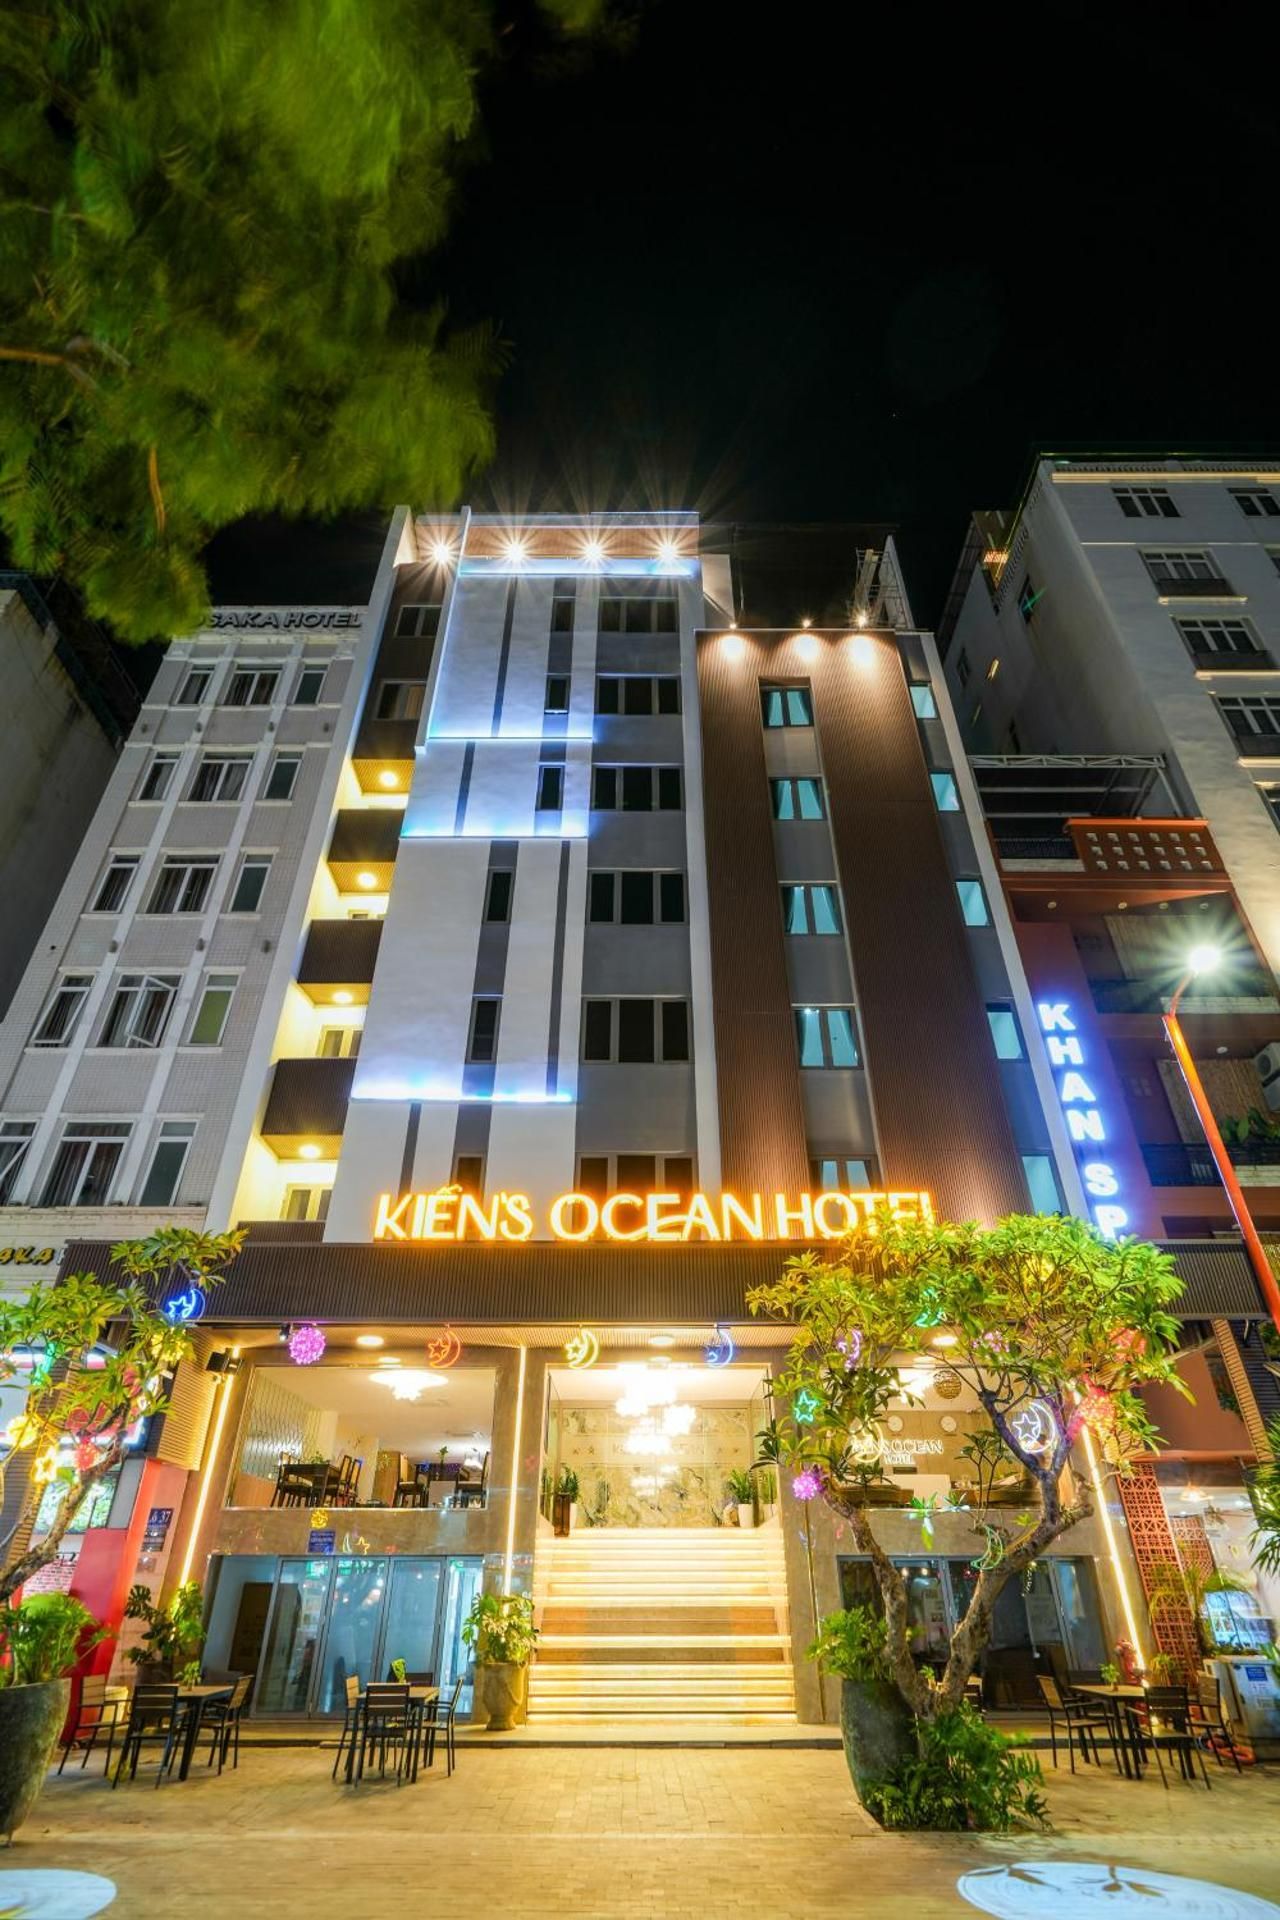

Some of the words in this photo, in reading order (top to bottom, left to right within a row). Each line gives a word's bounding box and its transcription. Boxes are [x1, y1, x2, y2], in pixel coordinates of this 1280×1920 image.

[198, 612, 280, 628] SAKA
[284, 611, 362, 628] HOTEL
[1038, 1003, 1106, 1141] KHAN
[1084, 1163, 1129, 1243] SP
[550, 1193, 764, 1242] OCEAN
